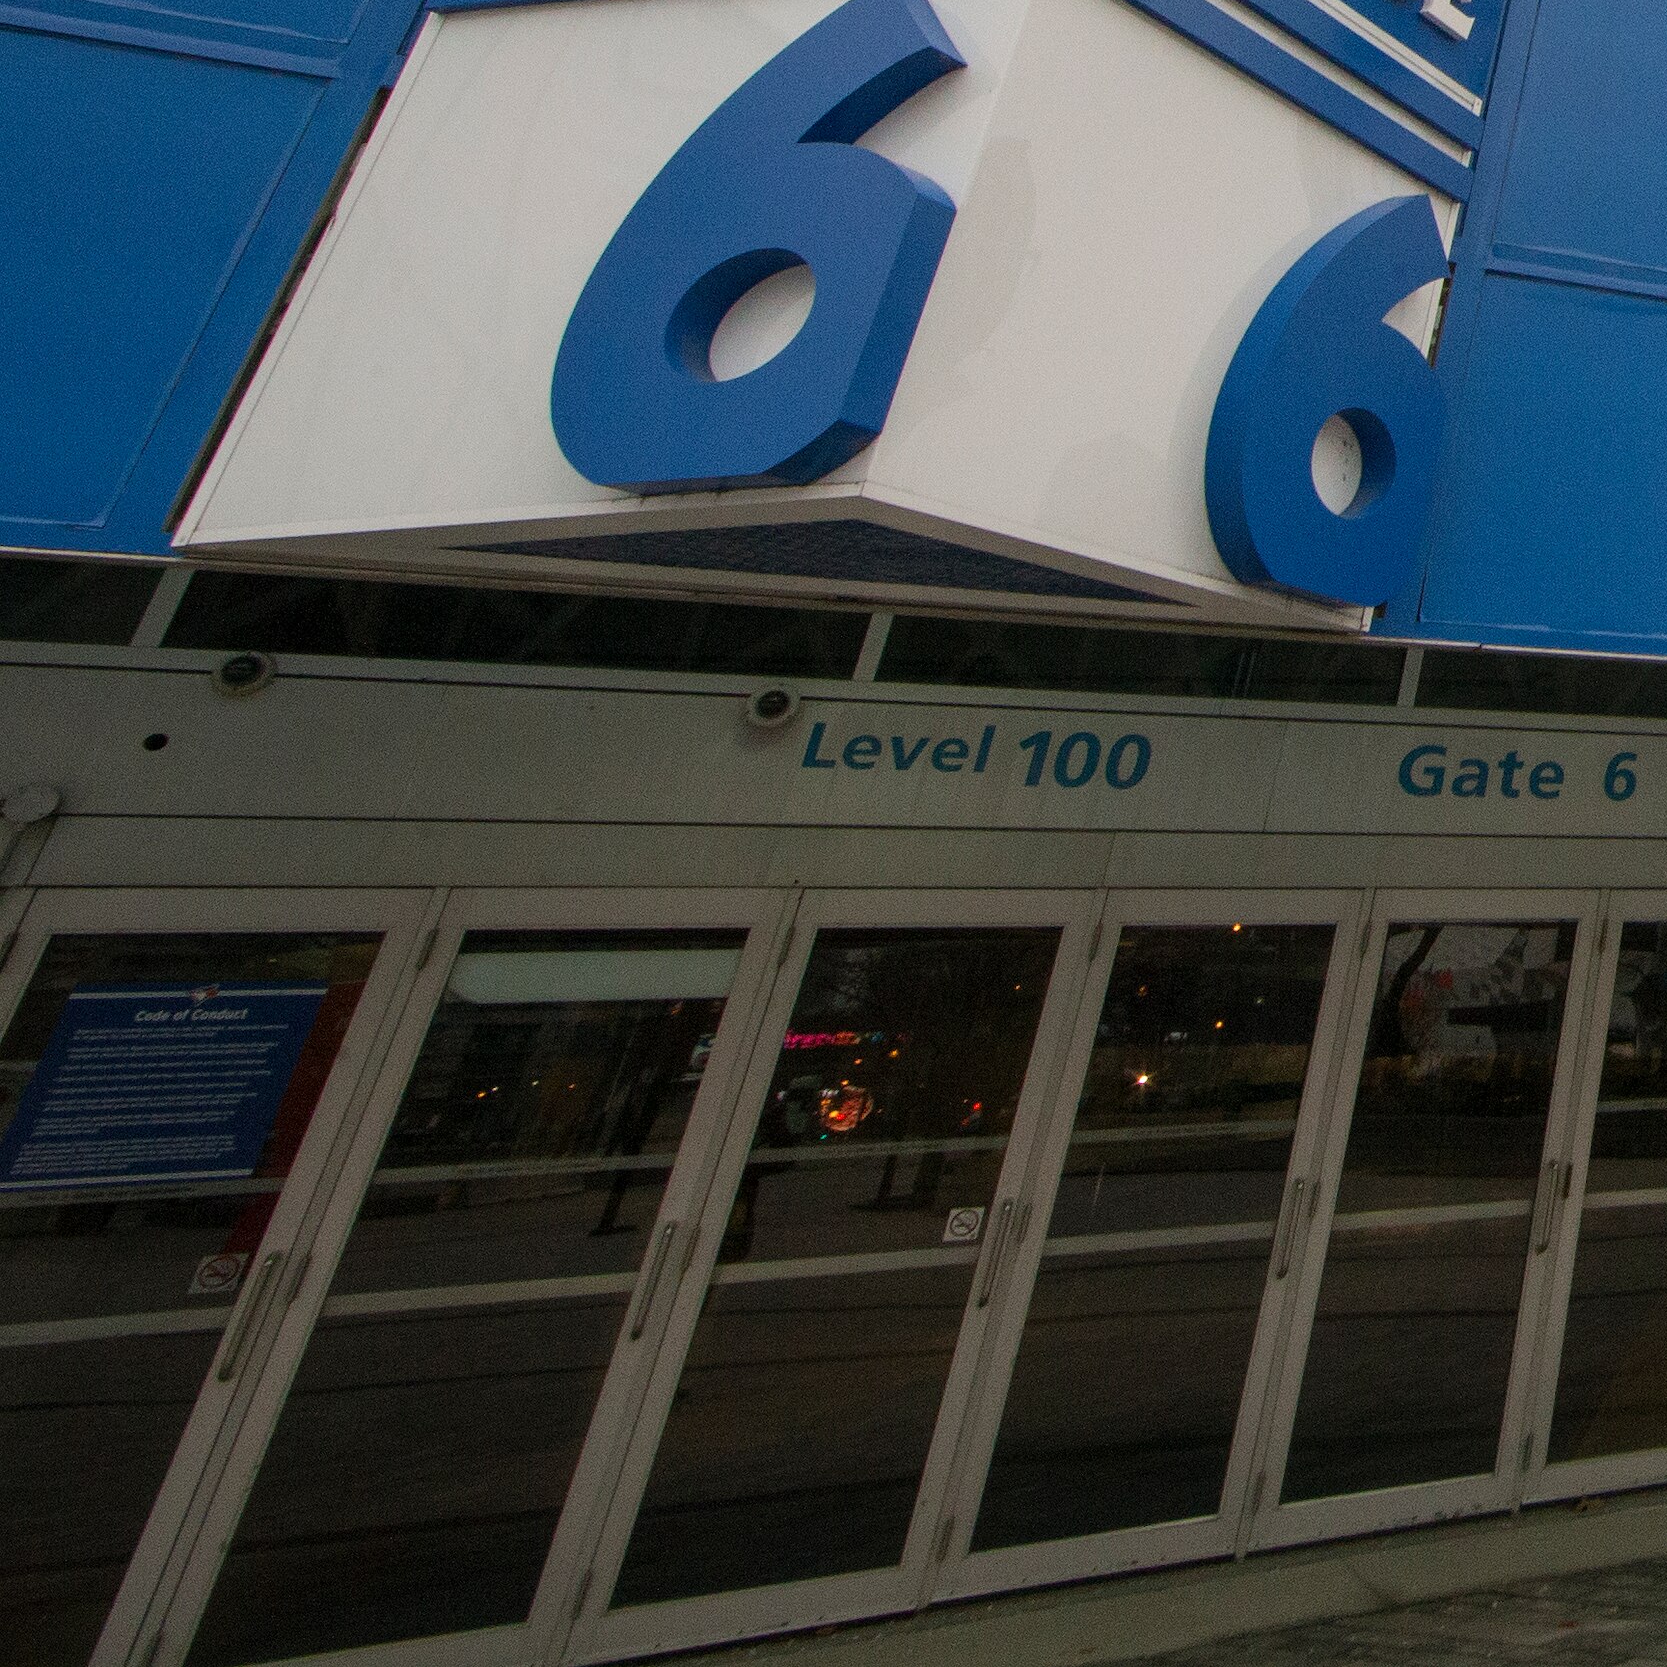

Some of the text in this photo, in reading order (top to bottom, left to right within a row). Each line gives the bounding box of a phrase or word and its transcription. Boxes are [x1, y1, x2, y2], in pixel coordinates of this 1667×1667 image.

[1205, 193, 1450, 606] 6
[803, 722, 1152, 790] Level 100
[1399, 744, 1637, 801] Gate 6
[135, 1007, 249, 1022] Code of Conduct
